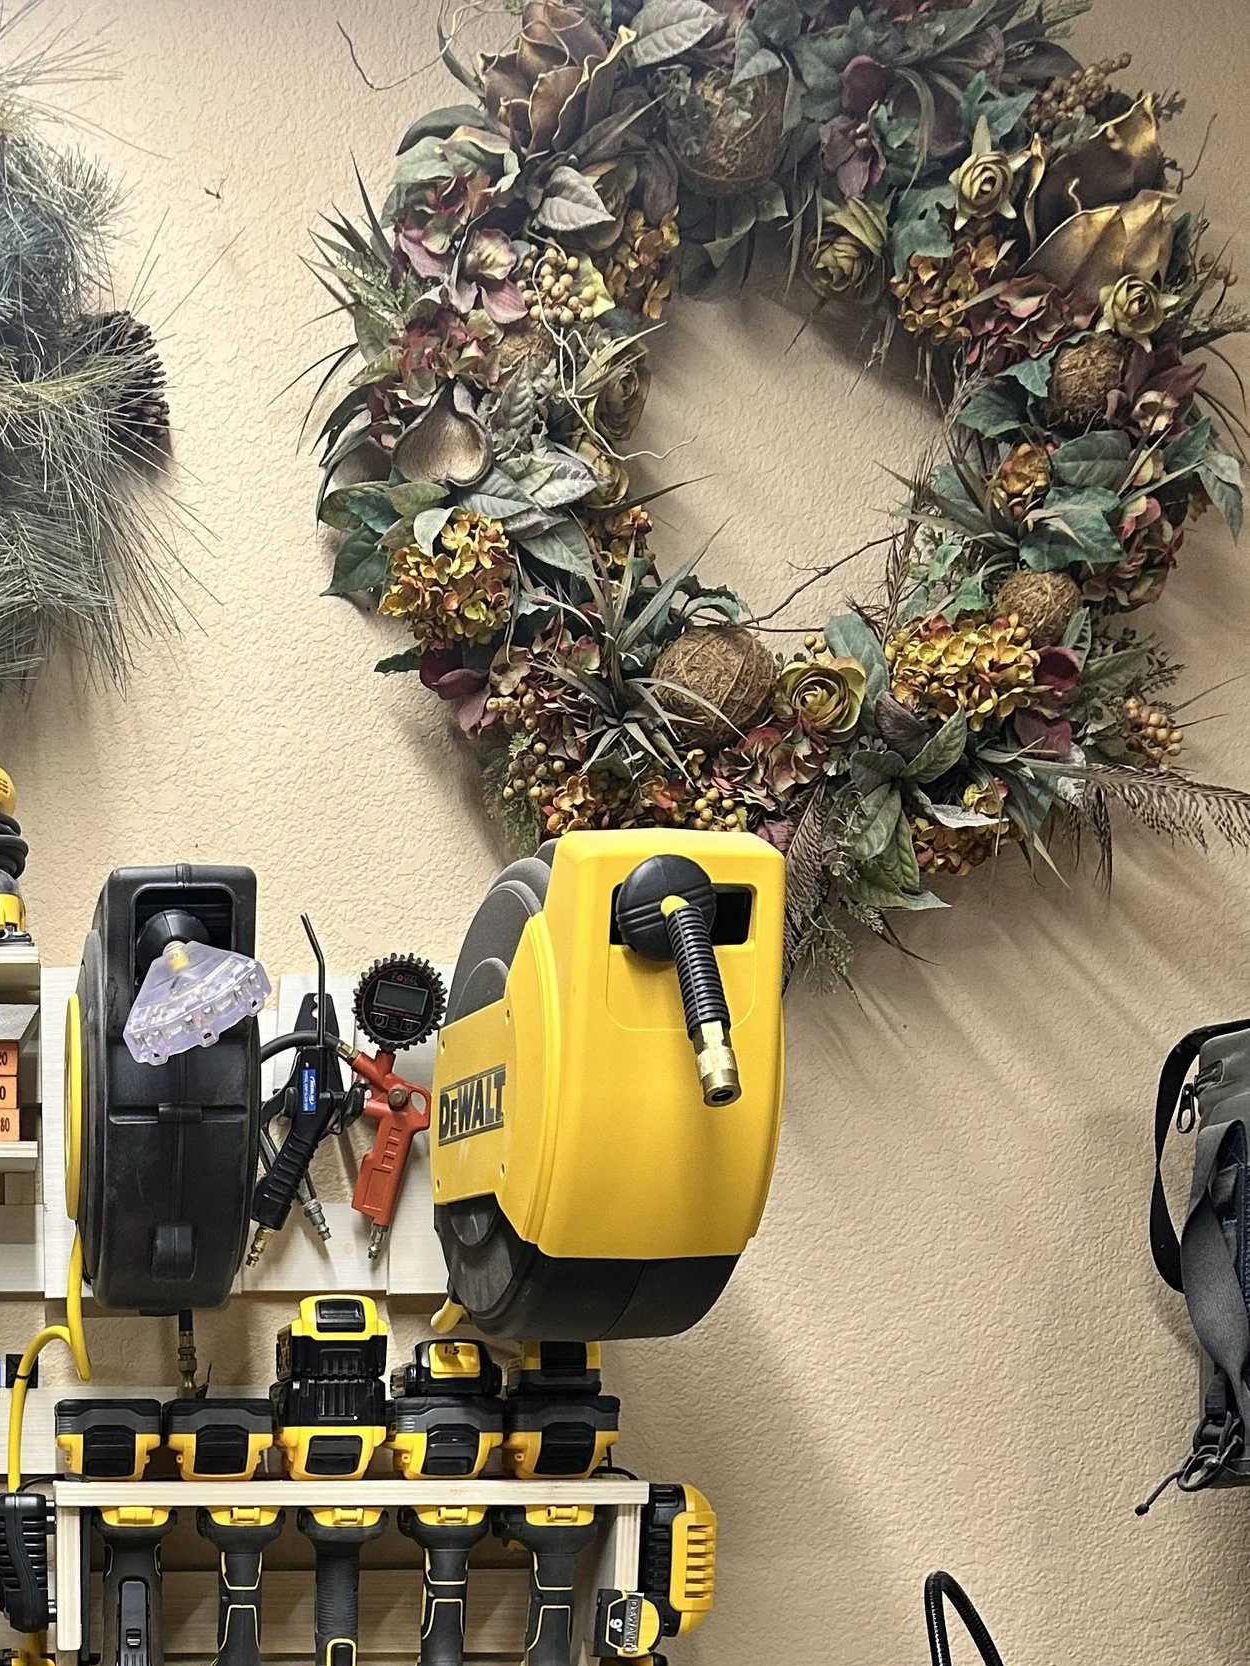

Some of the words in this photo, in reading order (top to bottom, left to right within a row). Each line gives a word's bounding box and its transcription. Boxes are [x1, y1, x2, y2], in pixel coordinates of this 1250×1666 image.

[128, 1000, 172, 1014] DEWALT
[155, 1069, 207, 1087] DEWALT
[439, 1070, 506, 1141] DEWALT
[444, 1346, 460, 1355] 1.5
